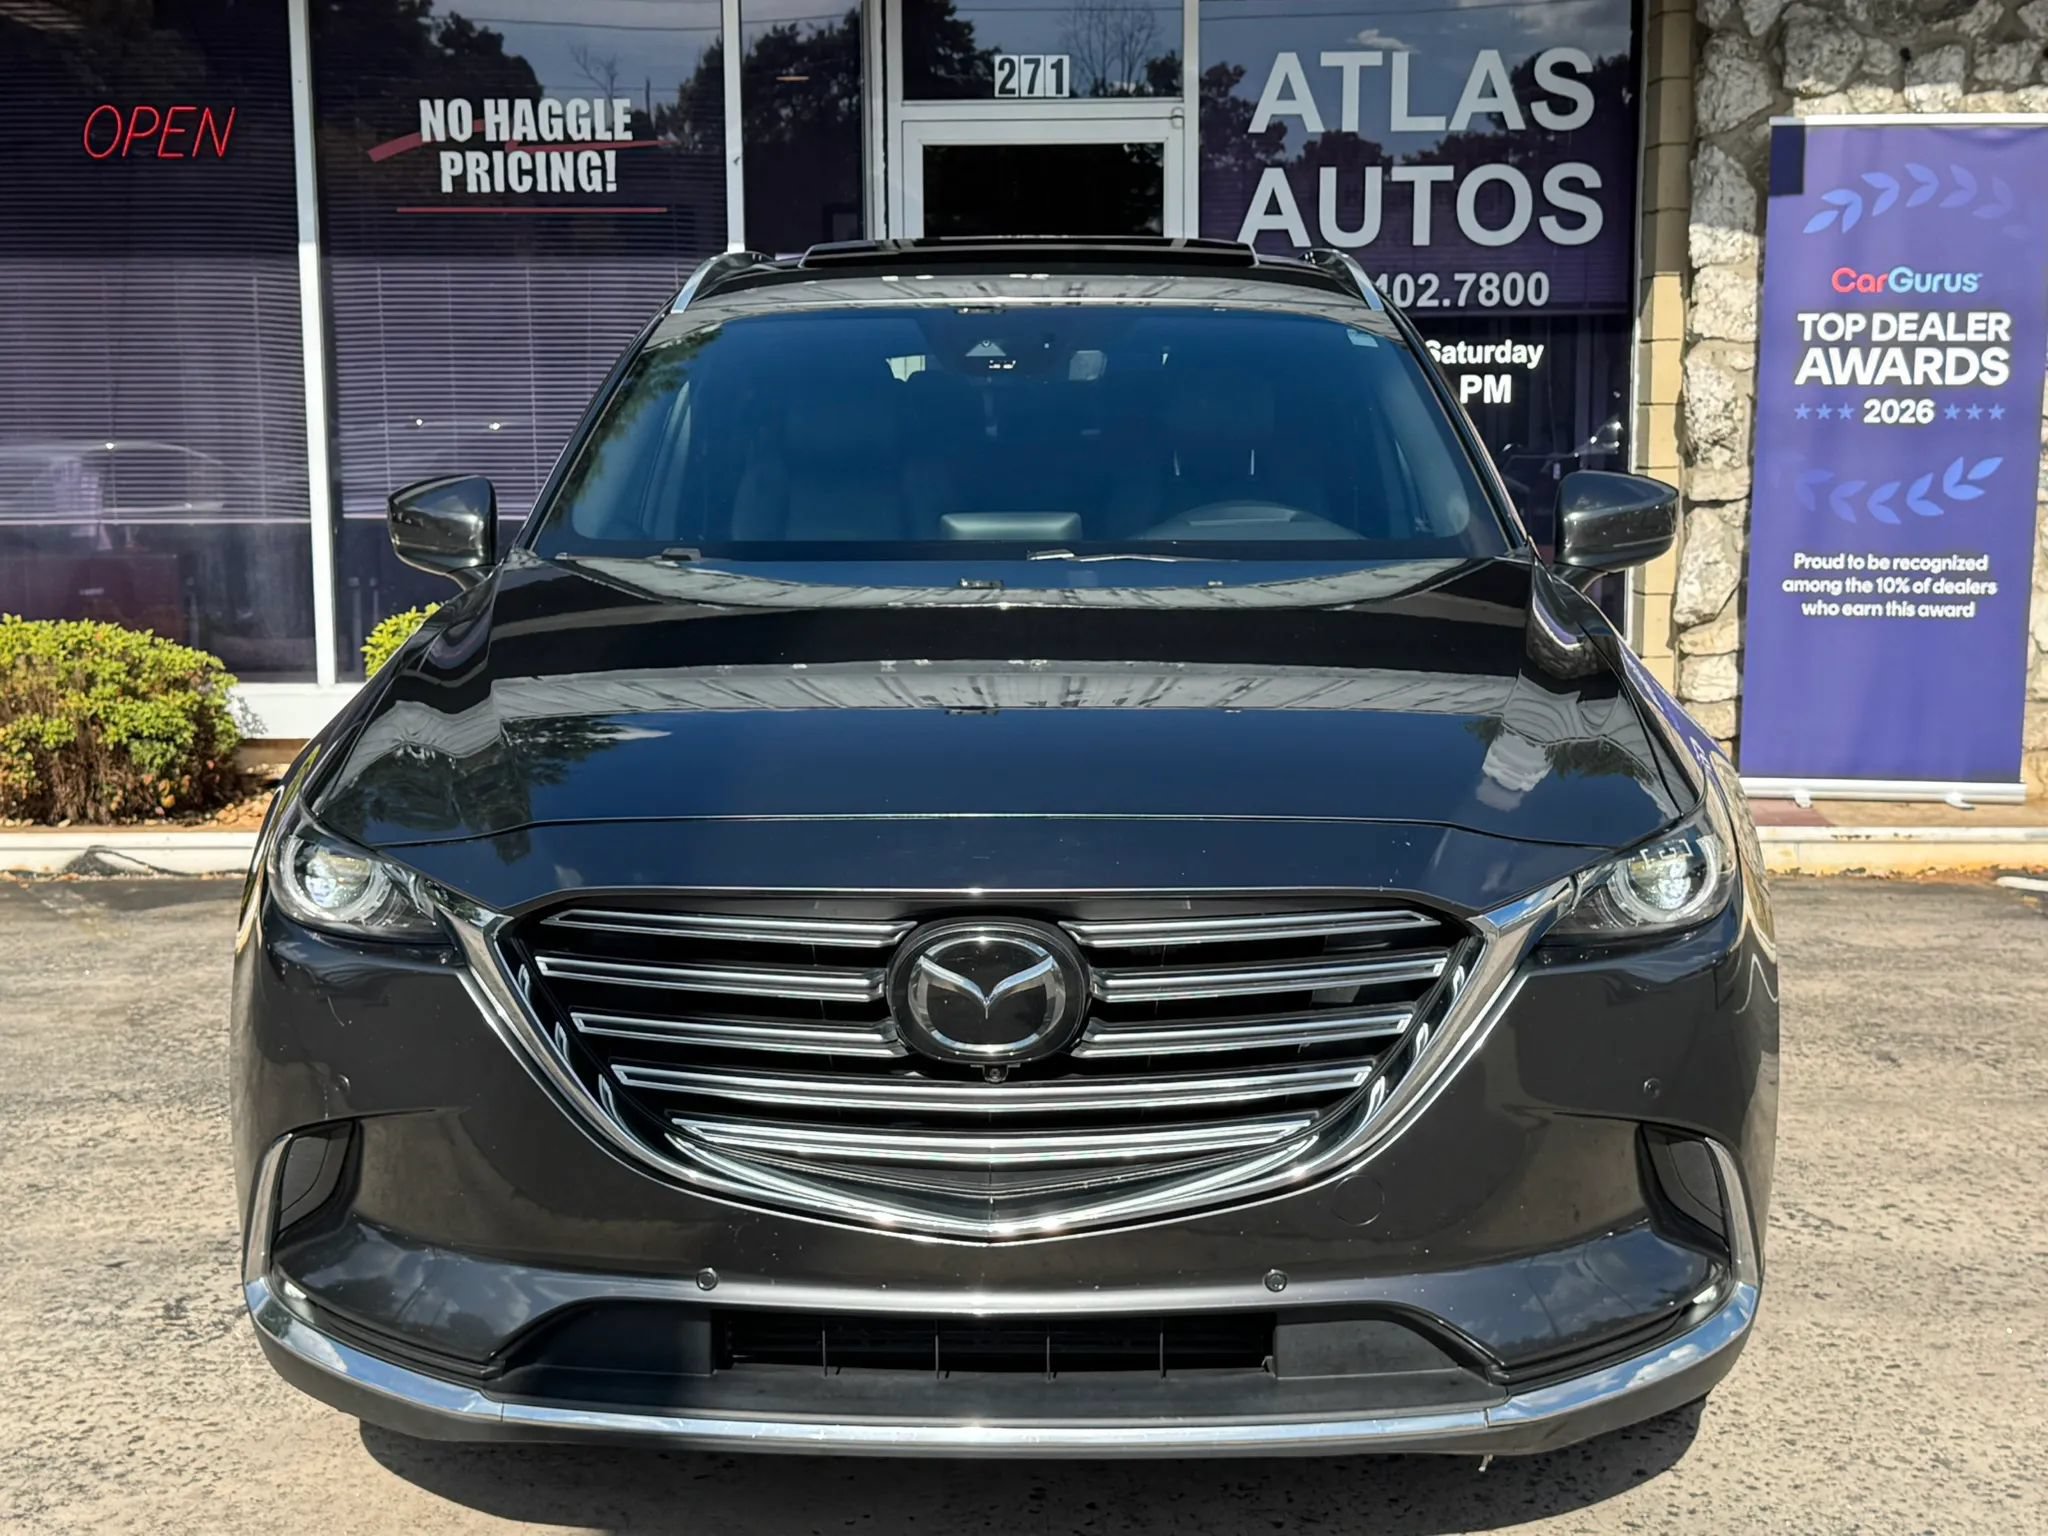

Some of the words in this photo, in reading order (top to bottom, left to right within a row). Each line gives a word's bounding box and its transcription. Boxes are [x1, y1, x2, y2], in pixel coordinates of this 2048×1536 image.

[998, 57, 1064, 95] 271
[1248, 47, 1595, 134] ATLAS
[84, 104, 237, 158] OPEN
[419, 98, 473, 142] NO
[483, 98, 633, 142] HAGGLE
[439, 150, 617, 193] PRICING!
[1237, 162, 1604, 248] AUTOS
[1831, 266, 1979, 294] CarGurus
[1797, 312, 1867, 342] TOP
[1872, 312, 2012, 342] DEALER
[1425, 339, 1545, 370] Saturday
[1794, 347, 2011, 386] AWARDS
[1460, 374, 1512, 404] PM
[1863, 398, 1936, 425] 2026
[1794, 552, 1845, 570] Proud
[1847, 554, 1865, 570] to
[1867, 554, 1890, 571] be
[1892, 554, 1989, 574] recognized
[1782, 578, 1842, 596] among
[1845, 577, 1874, 593] the
[1875, 577, 1910, 594] 10%
[1912, 577, 1932, 594] of
[1932, 578, 1998, 595] dealers
[1801, 600, 1839, 616] who
[1841, 602, 1883, 617] earn
[1886, 601, 1915, 617] this
[1917, 602, 1976, 618] award
